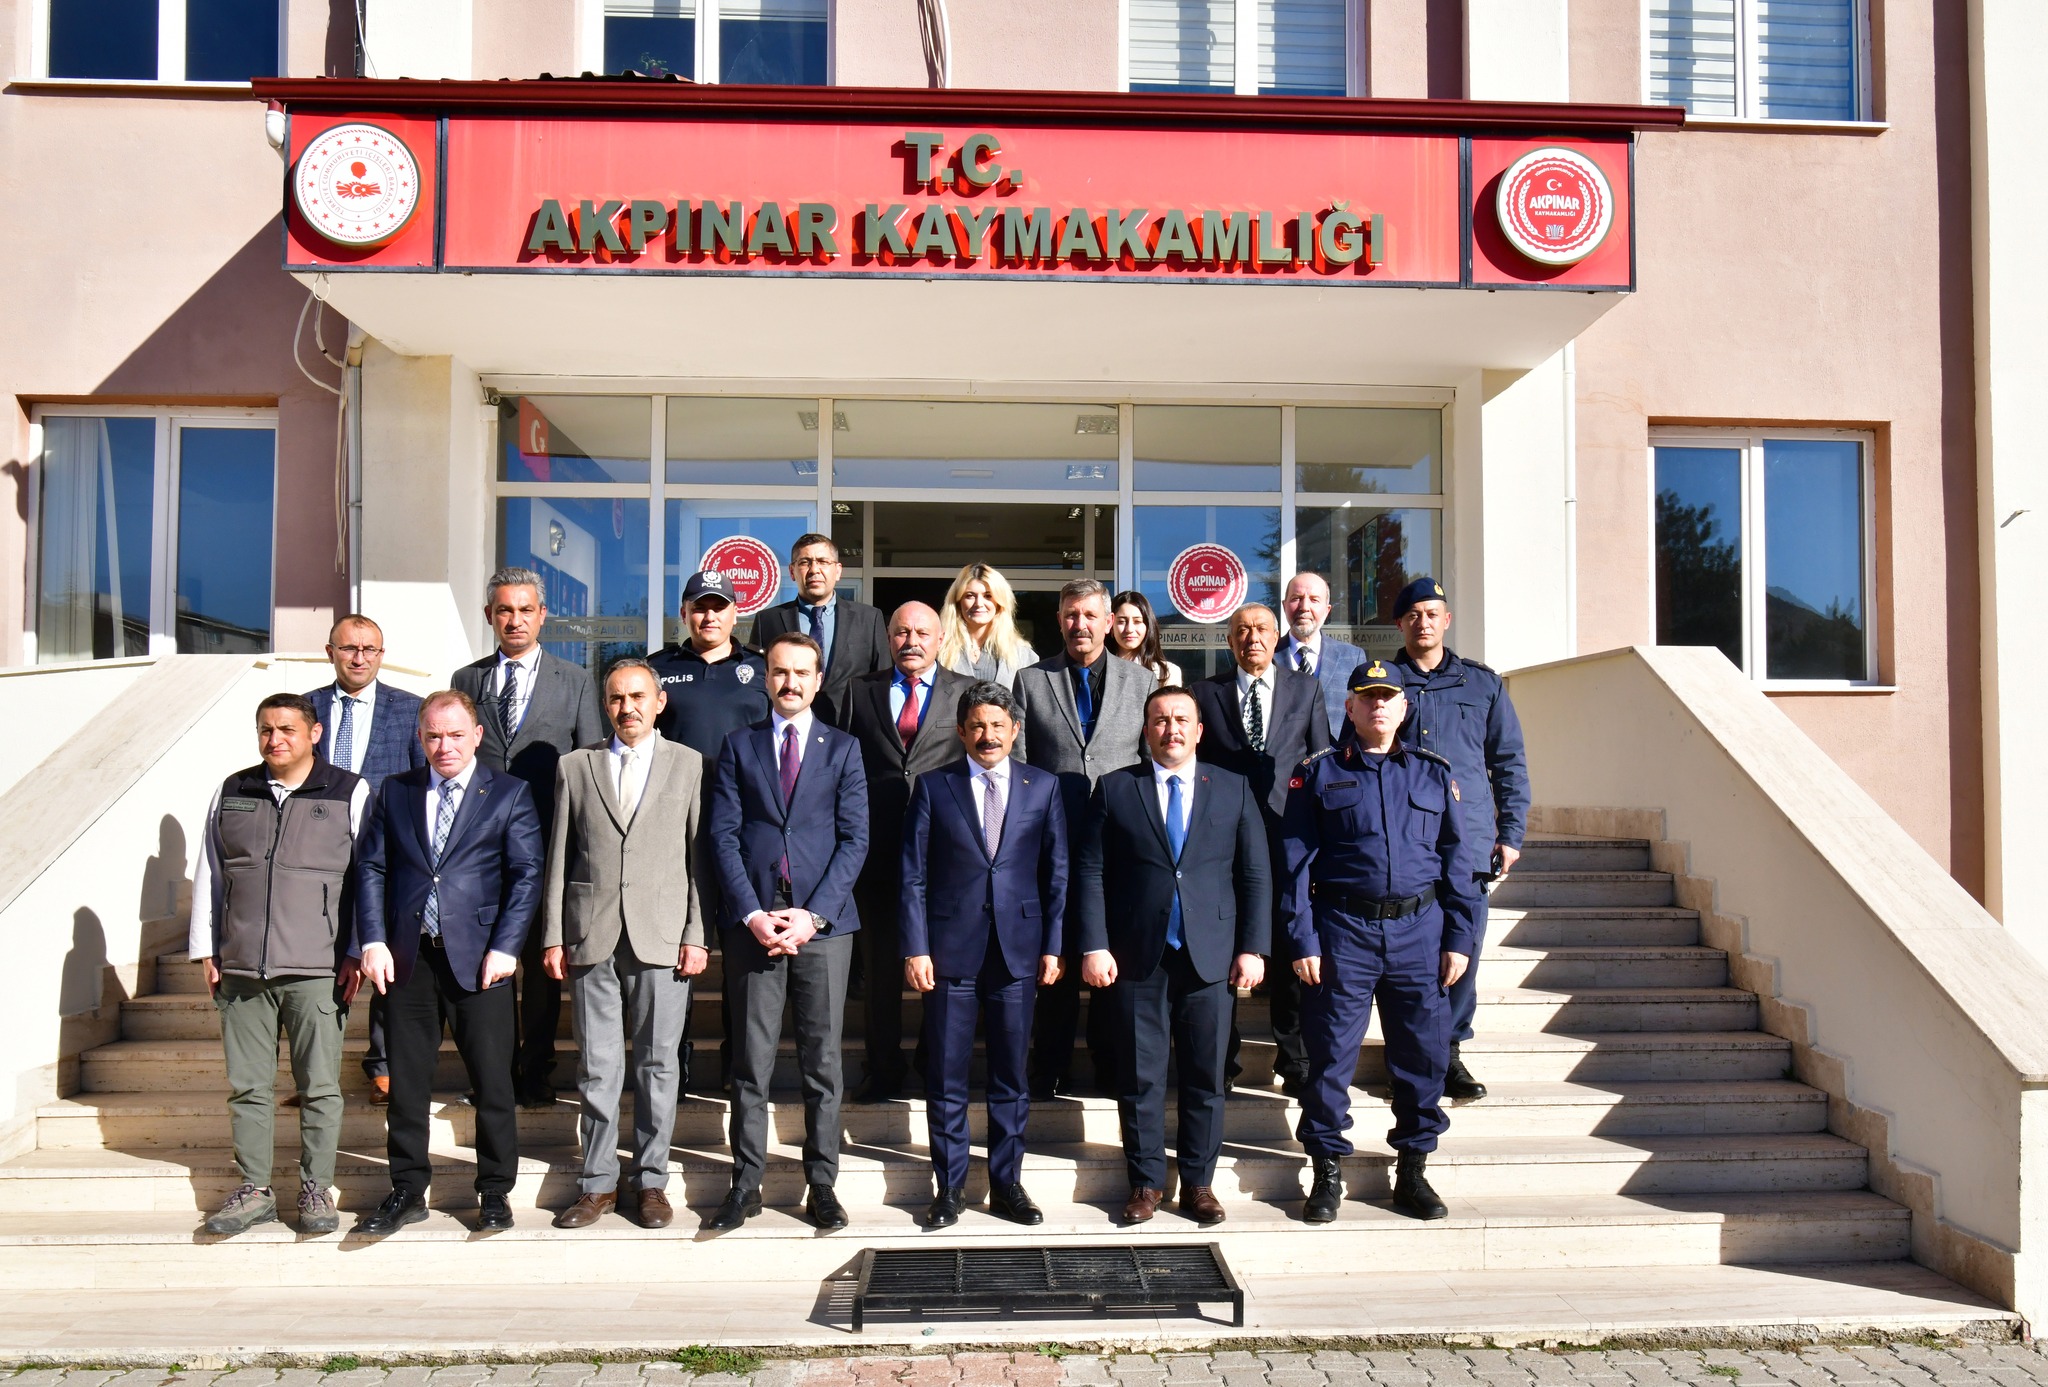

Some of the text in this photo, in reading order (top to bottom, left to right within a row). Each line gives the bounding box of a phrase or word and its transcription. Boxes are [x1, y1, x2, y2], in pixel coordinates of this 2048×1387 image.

[905, 131, 1022, 188] T.C.
[1529, 194, 1580, 210] AKPINAR
[528, 199, 1384, 266] AKPINAR KAYMAKAMLIĞI
[1188, 575, 1226, 587] AKPINAR
[1159, 633, 1187, 642] PINAR
